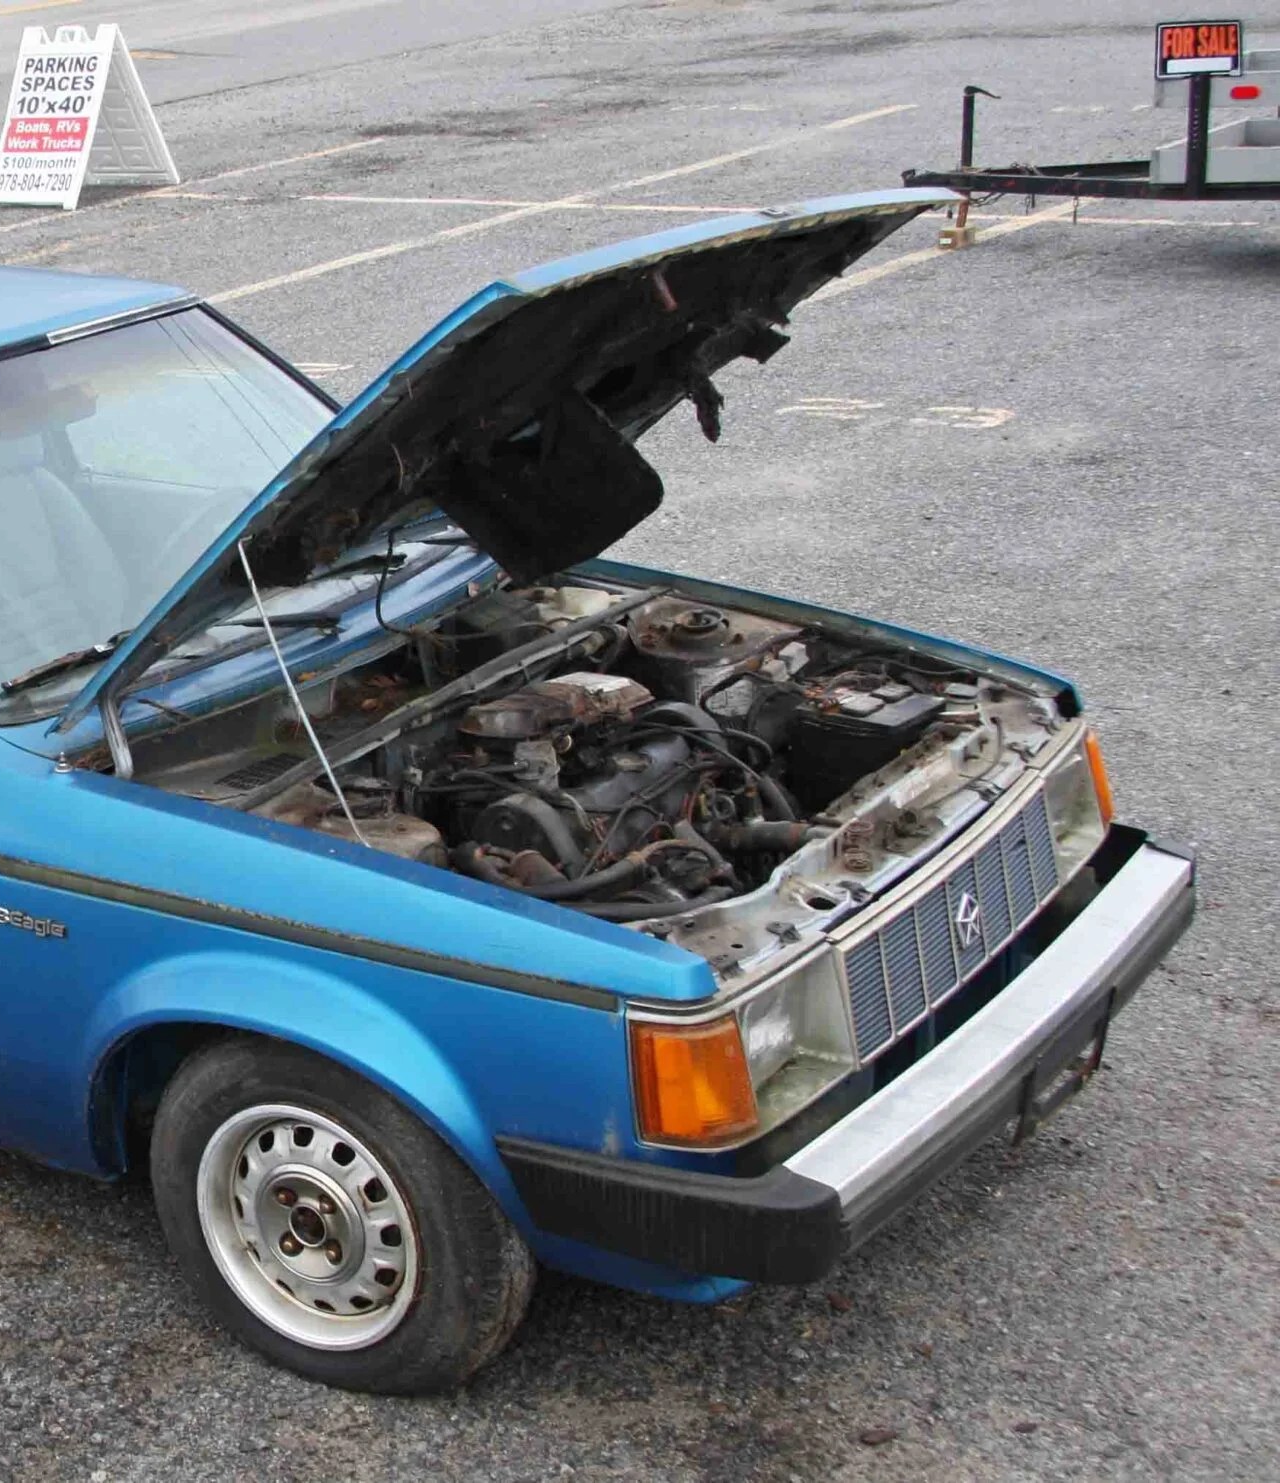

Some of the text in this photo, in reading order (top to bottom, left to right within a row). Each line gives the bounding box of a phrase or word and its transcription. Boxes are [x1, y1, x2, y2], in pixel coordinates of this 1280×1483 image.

[1163, 25, 1237, 58] FOR SALE
[24, 56, 97, 73] PARKING
[21, 75, 94, 92] SPACES
[17, 96, 91, 114] 10'x40'
[16, 120, 80, 134] Boats, RVs
[7, 136, 81, 149] Work Trucks
[3, 156, 76, 169] $100/month
